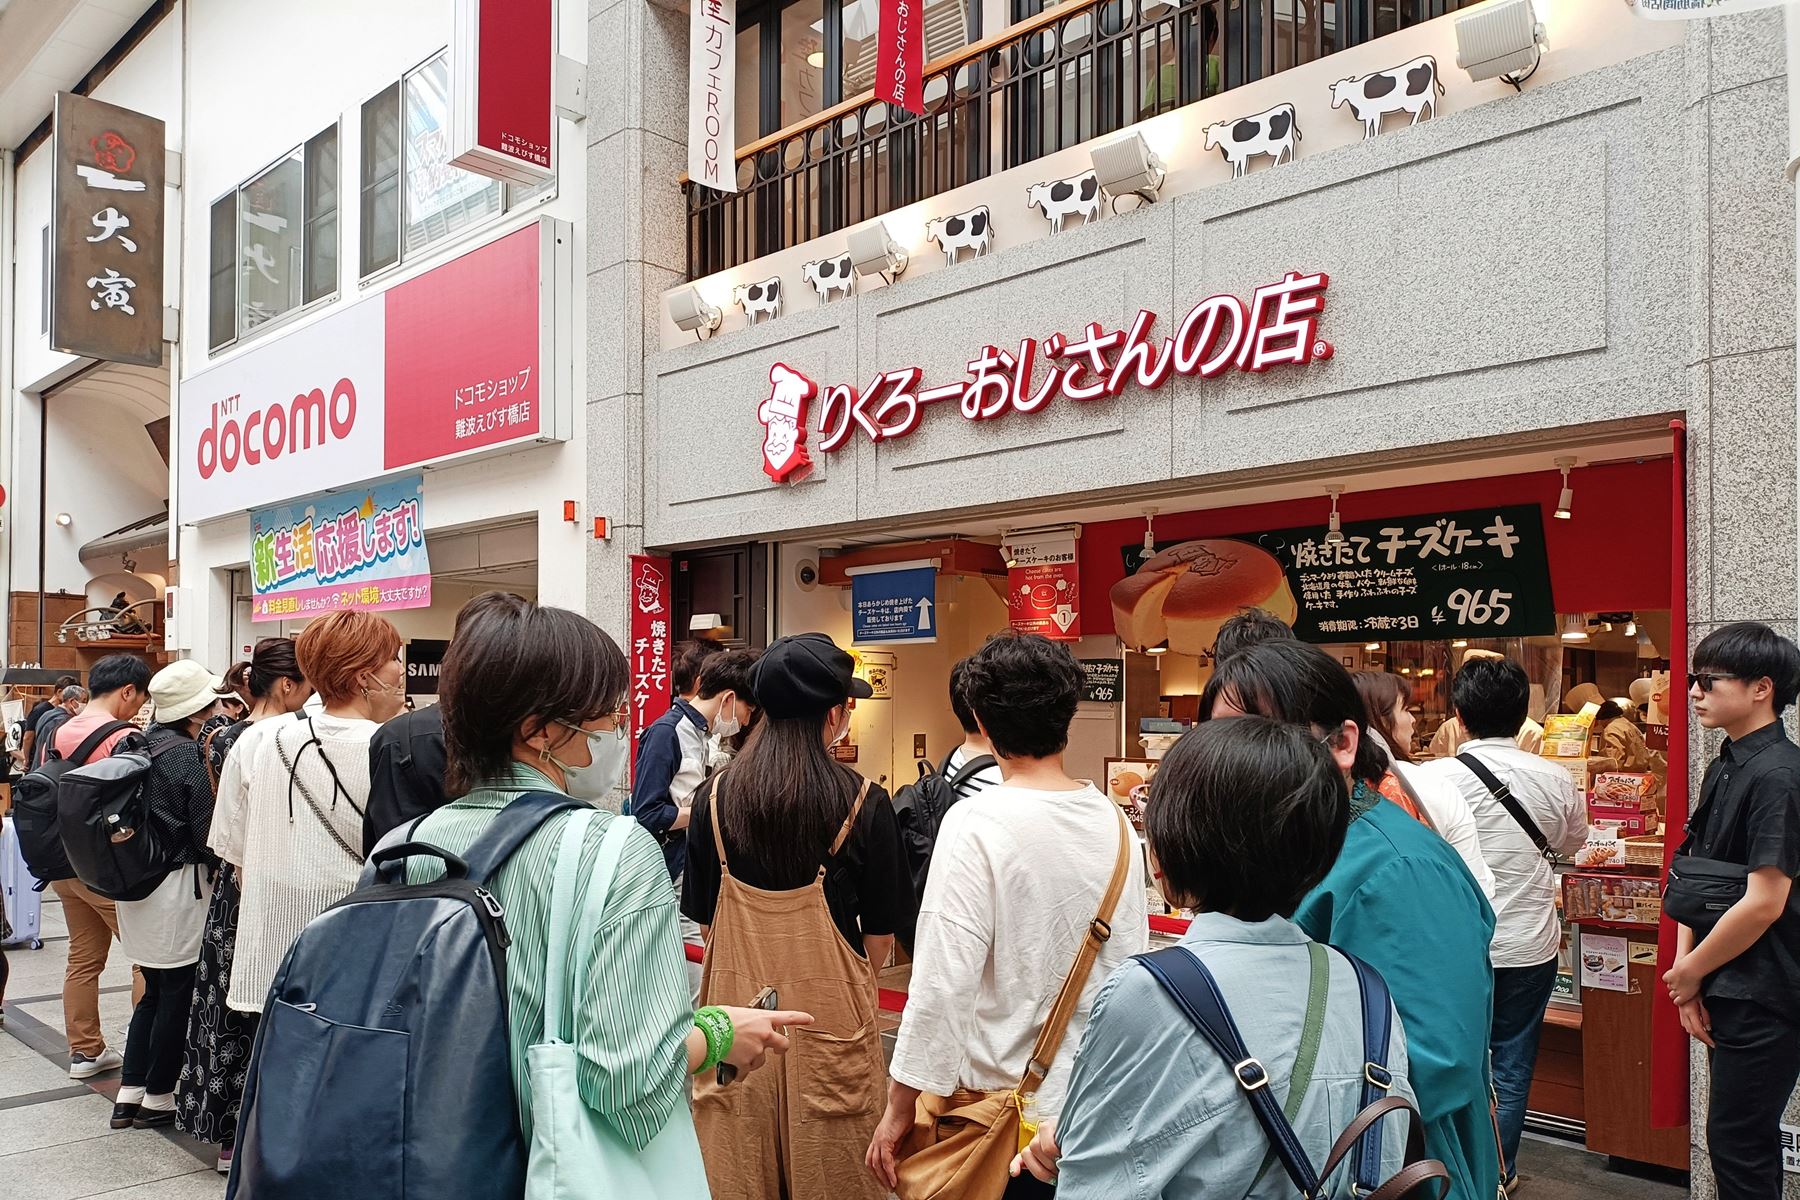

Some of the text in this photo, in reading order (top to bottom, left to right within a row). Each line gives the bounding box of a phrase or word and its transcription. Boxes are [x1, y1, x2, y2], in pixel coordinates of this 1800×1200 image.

[501, 132, 548, 152] ドコモショップ
[501, 143, 547, 164] 難波えびす橋店
[220, 394, 241, 417] NTT
[455, 366, 532, 410] ドコモショップ
[197, 377, 357, 480] docomo
[455, 400, 531, 439] 難波えびす橋店
[1290, 515, 1520, 569] 焼きたて チーズケーキ
[650, 620, 667, 691] 焼きたて
